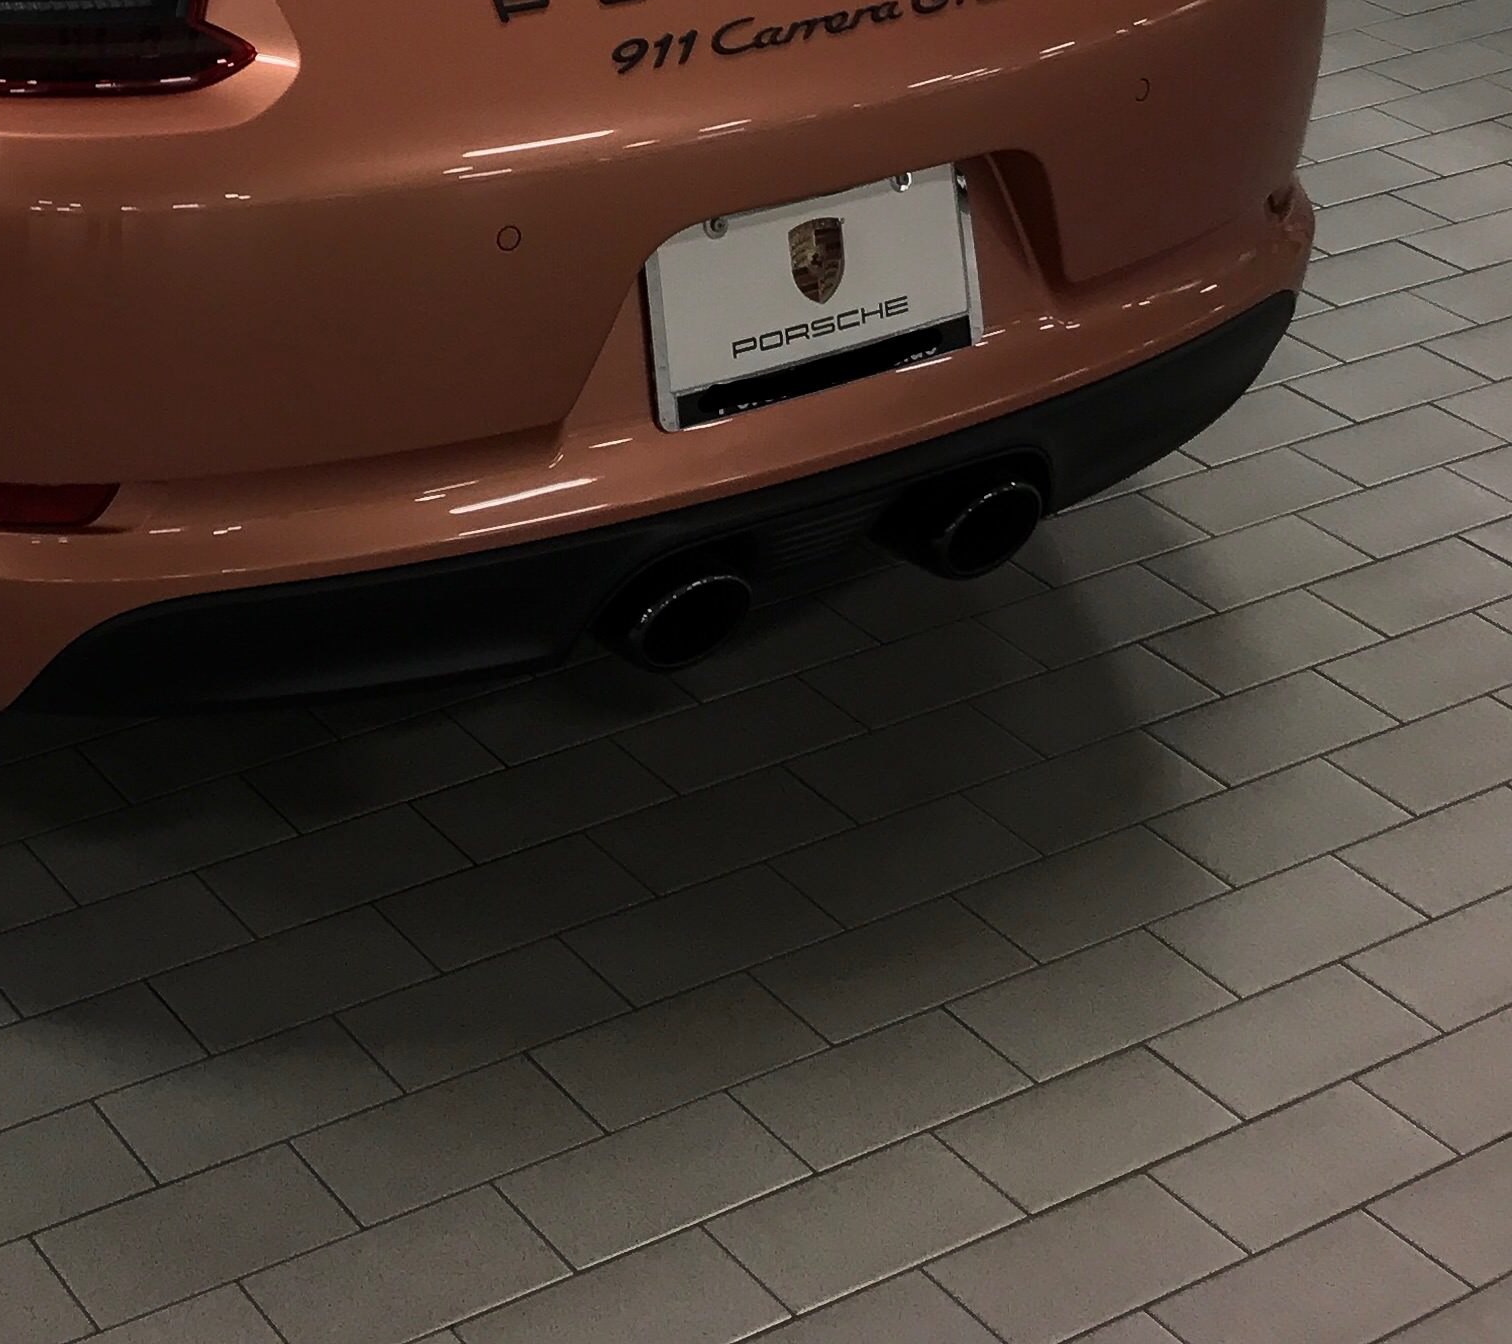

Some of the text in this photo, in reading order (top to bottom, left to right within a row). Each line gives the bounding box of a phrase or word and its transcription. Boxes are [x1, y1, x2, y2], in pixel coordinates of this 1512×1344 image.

[611, 29, 698, 75] 911
[710, 0, 901, 56] Carrera
[731, 295, 910, 359] PORSCHE
